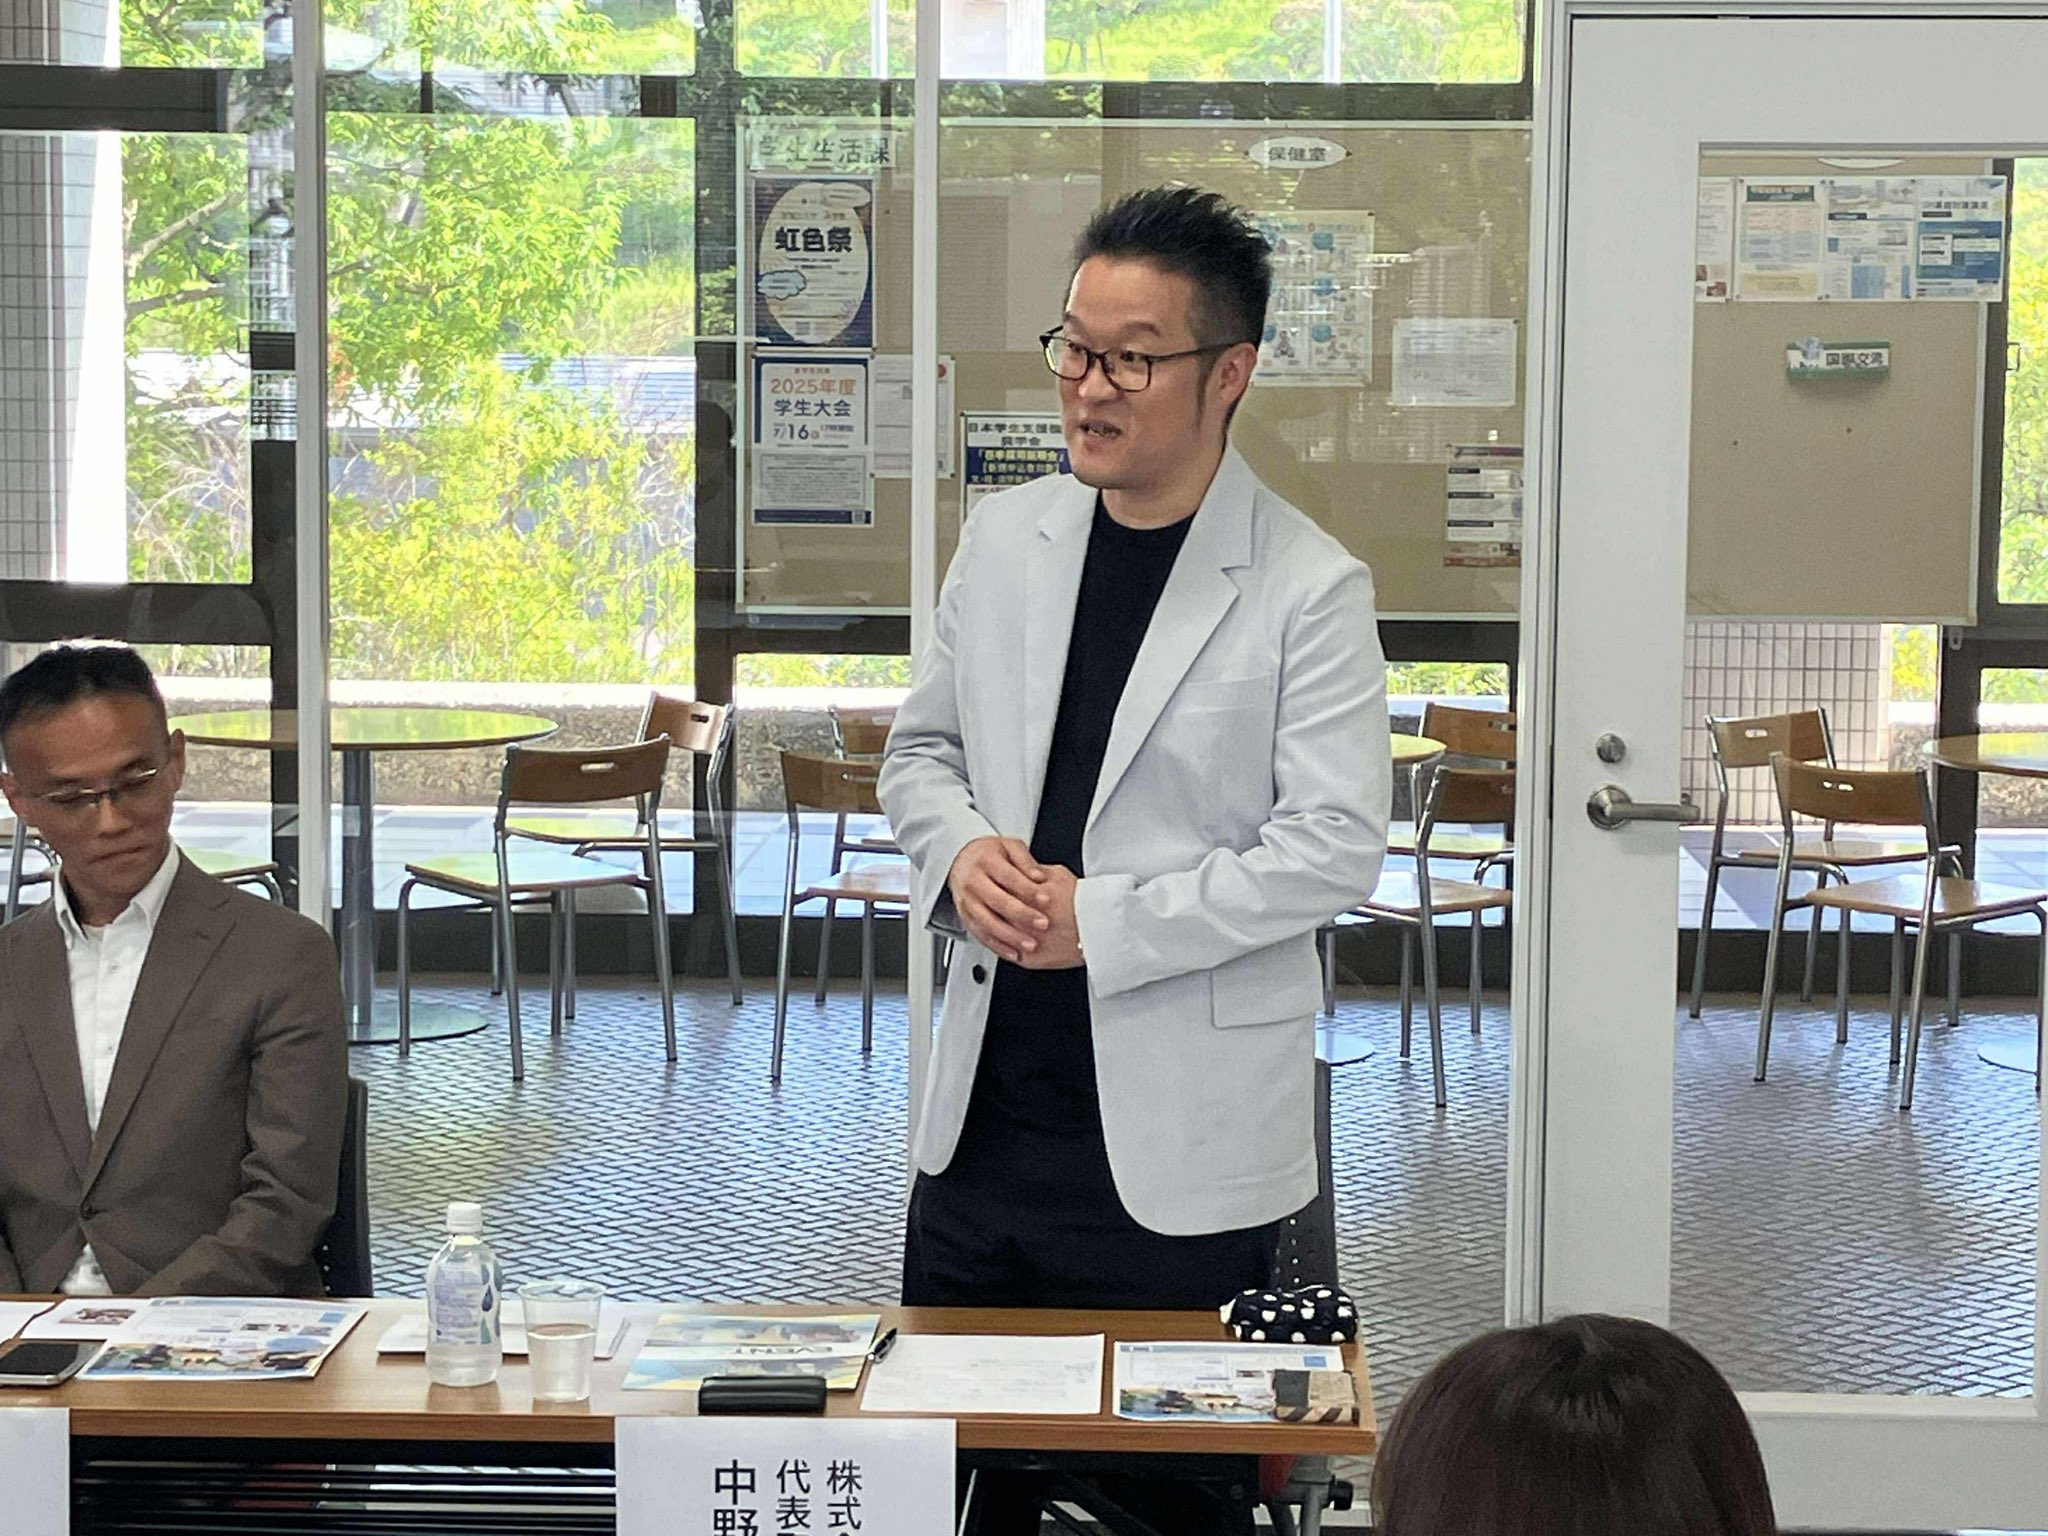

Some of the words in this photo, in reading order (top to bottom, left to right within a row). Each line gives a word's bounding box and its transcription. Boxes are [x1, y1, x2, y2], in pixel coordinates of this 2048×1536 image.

[775, 226, 853, 253] 虹色祭
[770, 378, 857, 396] 2025年度
[774, 398, 852, 417] 学生大会
[776, 1459, 811, 1536] 代表
[826, 1459, 862, 1536] 株式
